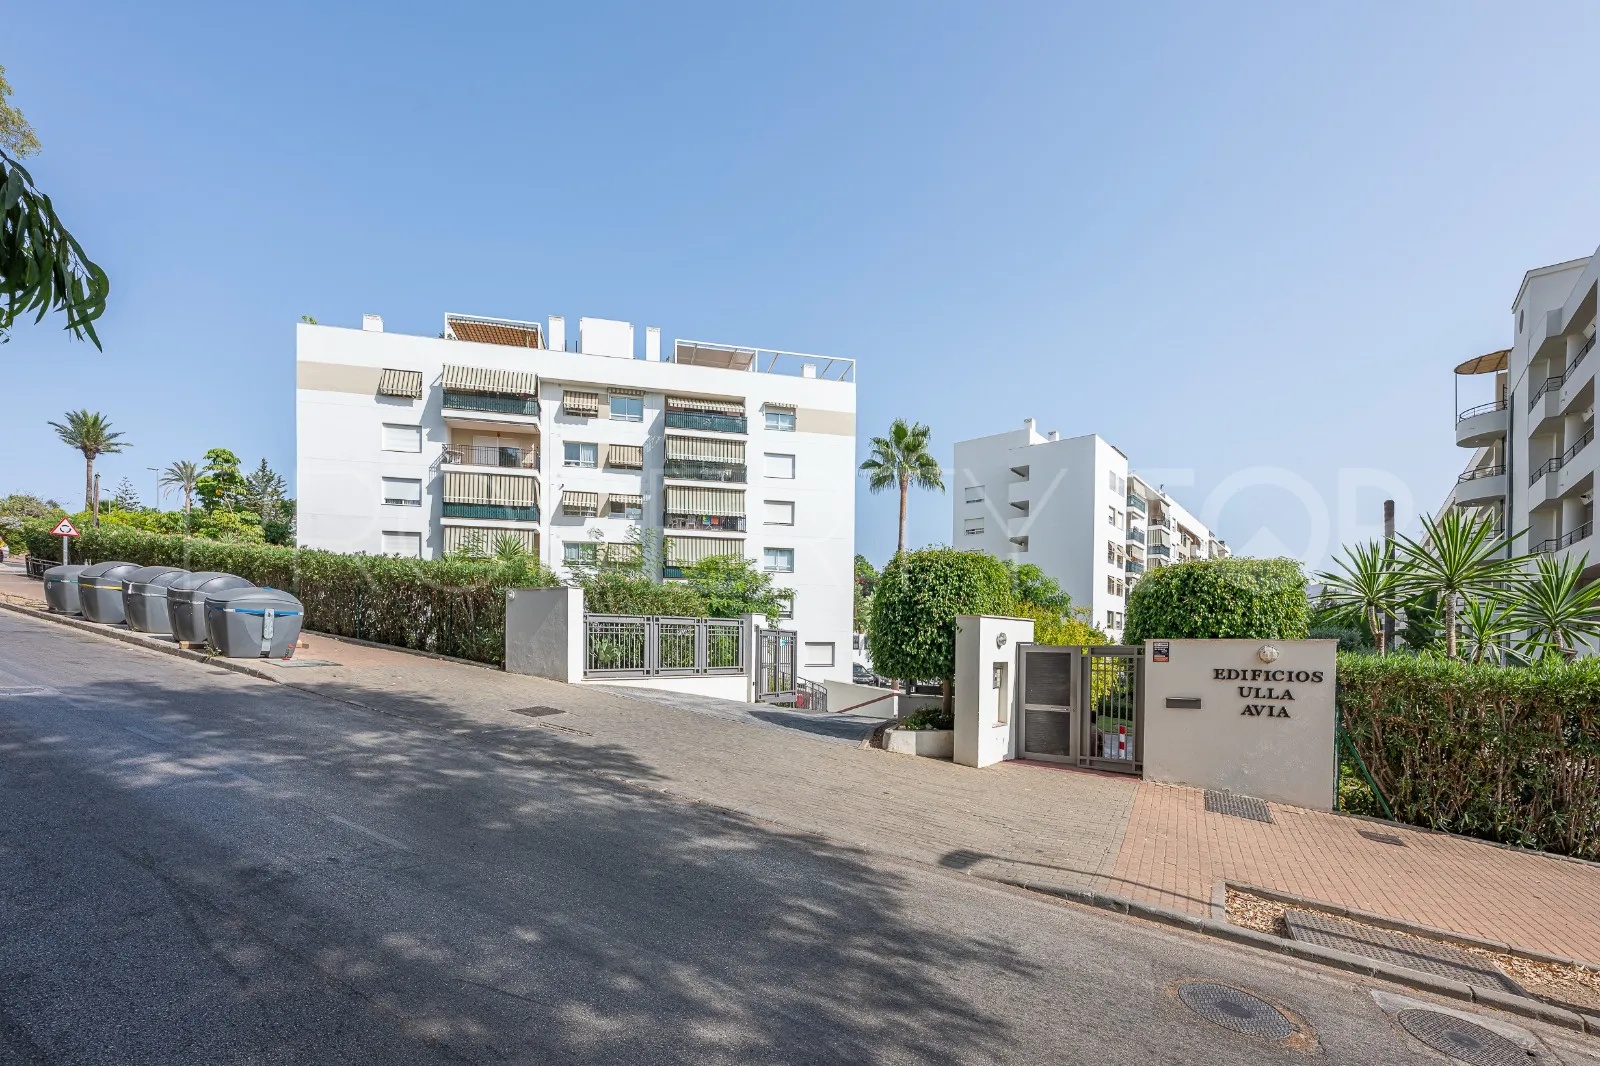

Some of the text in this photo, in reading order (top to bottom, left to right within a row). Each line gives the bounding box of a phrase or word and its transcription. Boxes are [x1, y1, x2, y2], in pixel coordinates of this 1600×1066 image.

[1213, 668, 1324, 683] EDIFICIOS
[1238, 686, 1295, 701] ULLA
[1240, 704, 1291, 718] AVIA
